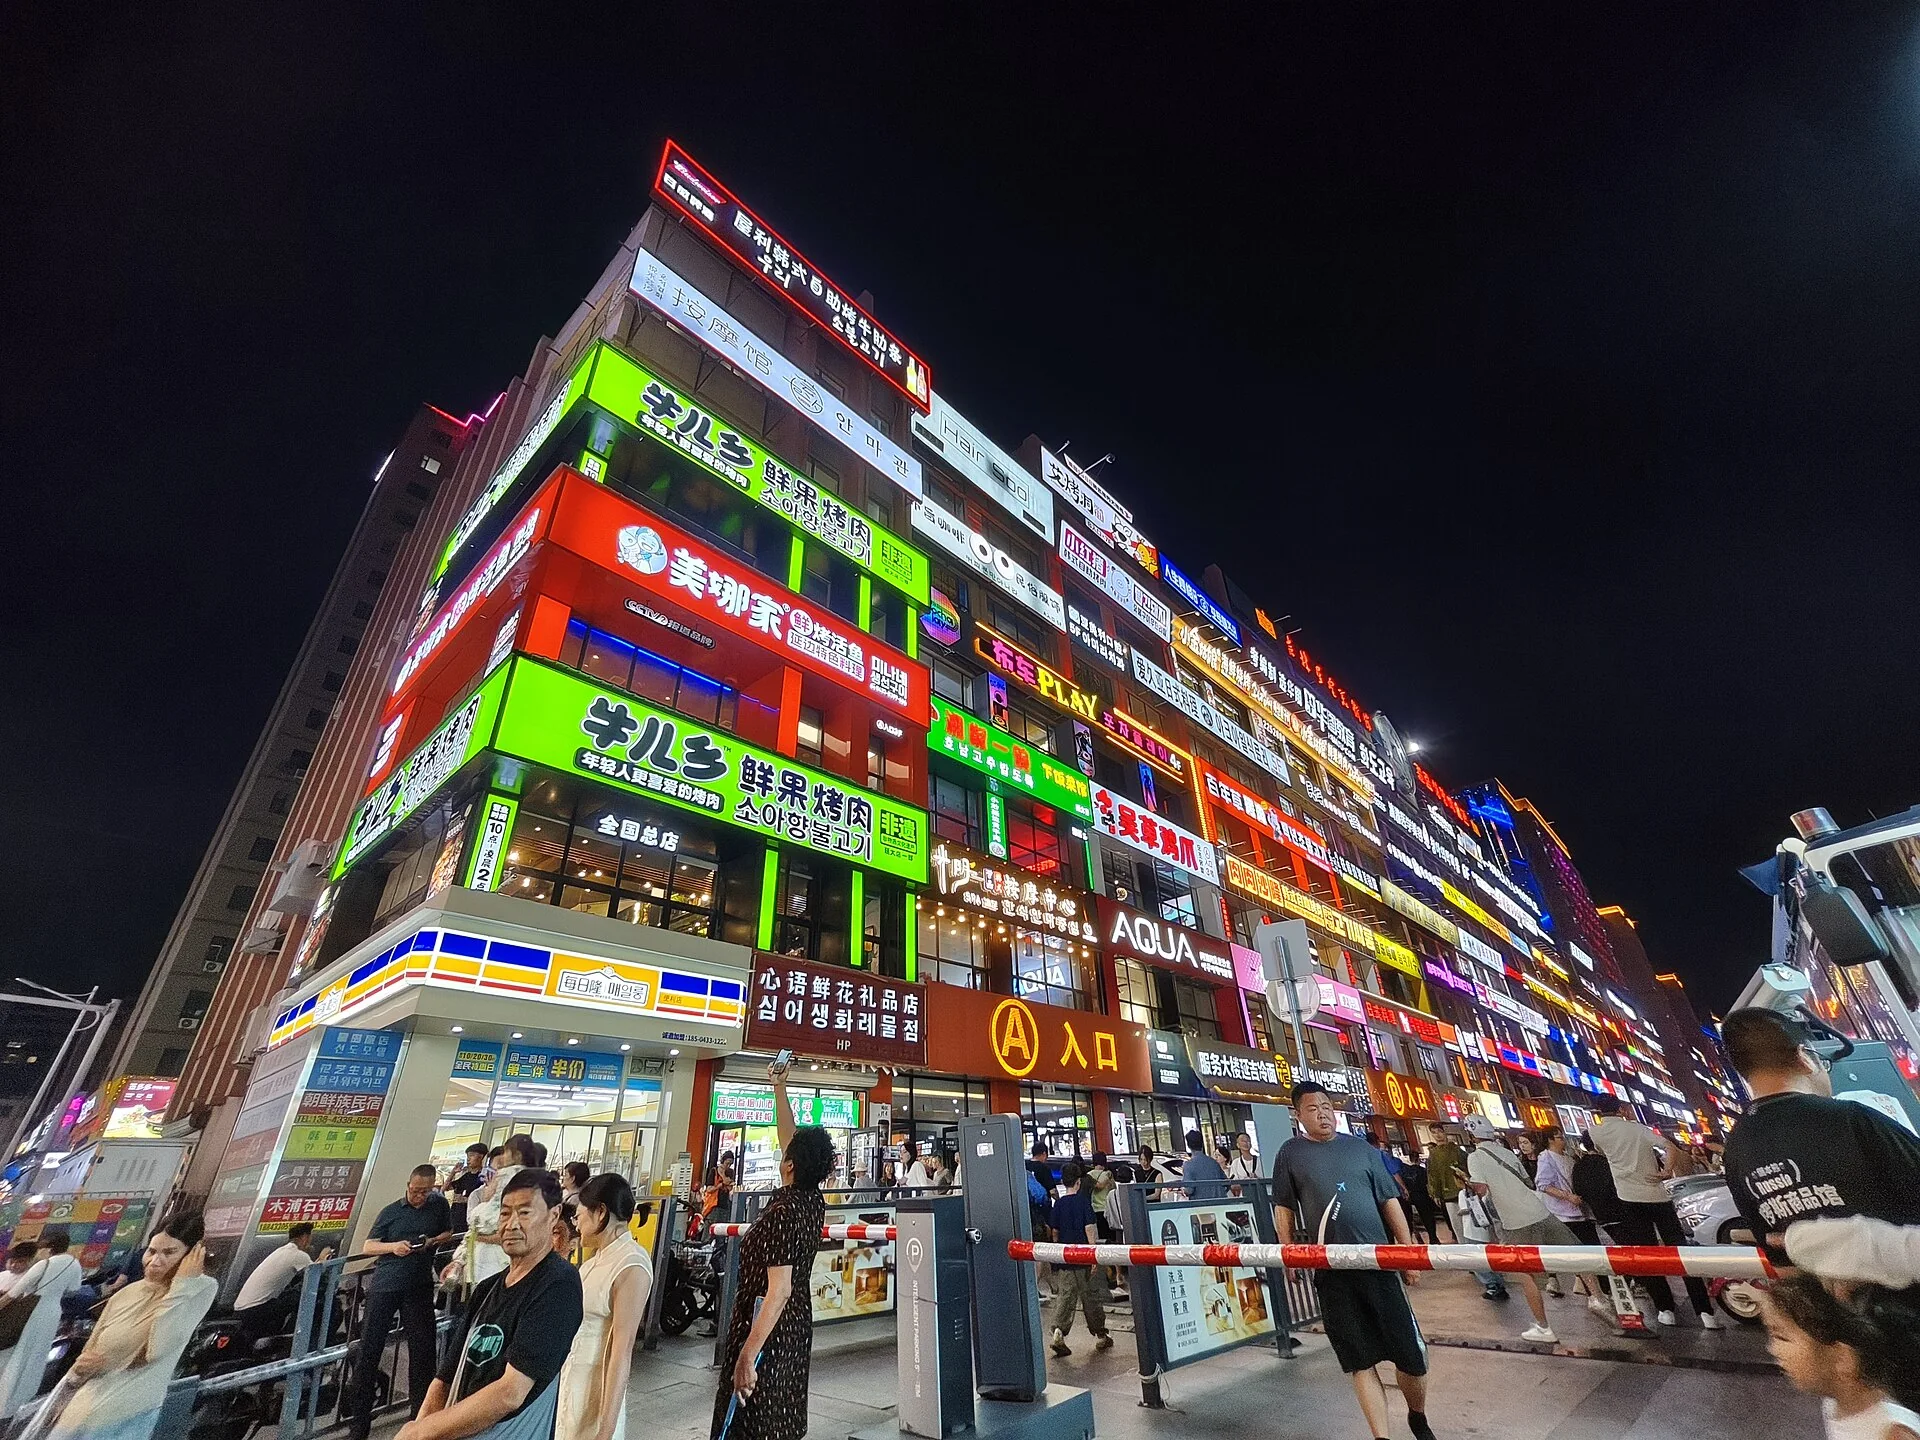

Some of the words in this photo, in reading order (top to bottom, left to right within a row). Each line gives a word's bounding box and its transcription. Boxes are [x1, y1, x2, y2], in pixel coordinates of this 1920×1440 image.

[757, 254, 791, 288] 우리
[671, 287, 773, 376] 按摩馆
[943, 419, 985, 462] Hair
[762, 458, 873, 547] 鲜果烤肉
[669, 547, 784, 640] 美娜家
[790, 631, 864, 679] 延边特色料理
[793, 611, 864, 661] 鲜烤活鱼
[1036, 666, 1099, 721] PLAY
[580, 750, 721, 811] 年轻人更喜爱的烤肉
[738, 753, 874, 836] 鲜果烤肉
[1041, 762, 1088, 798] 下饭菜馆
[597, 813, 680, 852] 全国总店
[733, 797, 873, 863] 소아향불고기
[1003, 874, 1076, 917] 按摩中心
[1111, 911, 1199, 969] AQUA
[564, 975, 603, 994] 每日隆
[662, 994, 682, 1004] 便利店
[759, 966, 919, 1016] 心语鲜花礼品店
[757, 994, 919, 1043] 심어생화례물점
[509, 1052, 547, 1065] 同一商品
[836, 1038, 851, 1051] HP
[1059, 1021, 1118, 1072] 入口
[506, 1063, 545, 1078] 第二件
[551, 1058, 585, 1080] 半价
[1198, 1051, 1277, 1086] 服务大楼延吉冷面
[301, 1093, 383, 1110] 朝鲜族民宿
[1403, 1082, 1430, 1112] 入口
[267, 1197, 351, 1213] 木浦石锅饭
[912, 1279, 920, 1322] INTELLIGENT
[913, 1323, 921, 1358] PARKING
